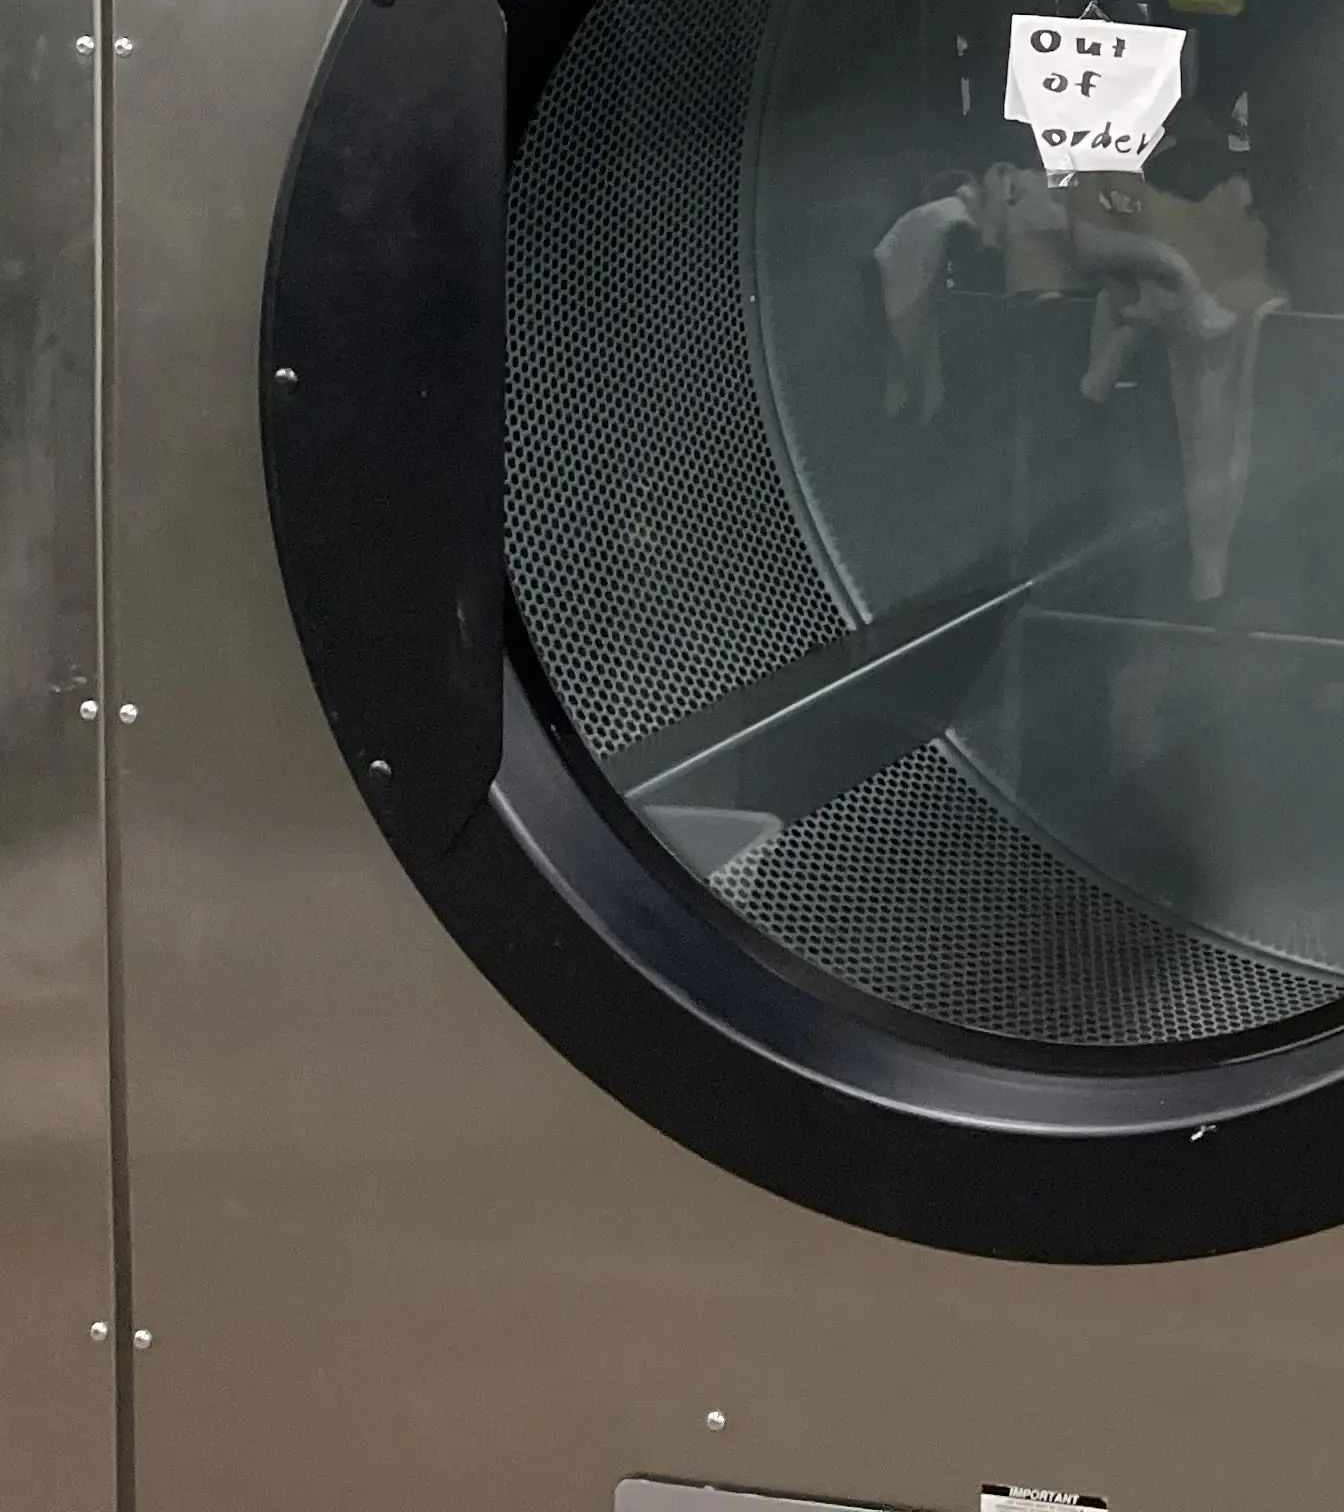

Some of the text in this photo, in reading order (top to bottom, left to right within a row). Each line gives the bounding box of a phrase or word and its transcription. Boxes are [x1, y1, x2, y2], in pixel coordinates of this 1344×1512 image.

[1030, 29, 1126, 58] Out
[1042, 70, 1102, 98] of
[1041, 121, 1150, 155] order
[1008, 1485, 1080, 1506] IMPORTANT
